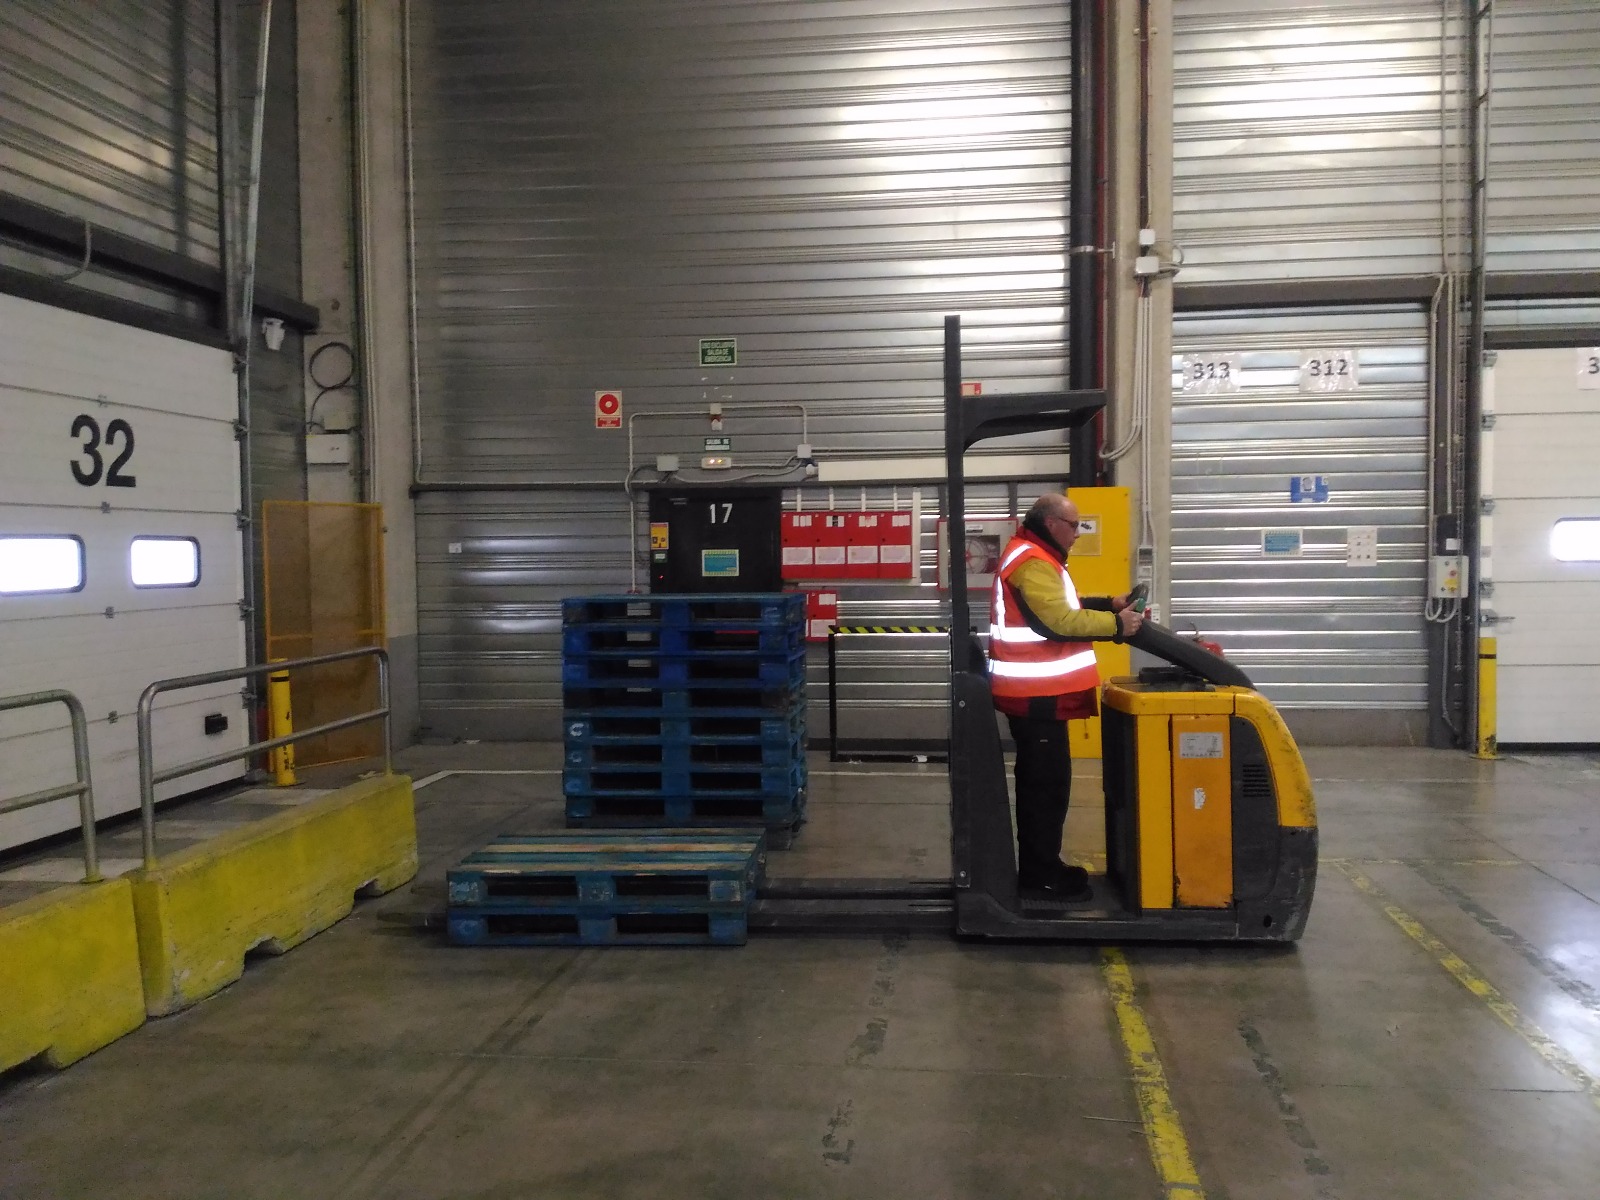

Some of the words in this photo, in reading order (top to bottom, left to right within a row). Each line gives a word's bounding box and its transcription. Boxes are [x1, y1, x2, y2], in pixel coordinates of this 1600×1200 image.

[1193, 362, 1230, 380] 313
[1309, 358, 1349, 376] 312
[70, 414, 136, 487] 32
[709, 503, 733, 524] 17
